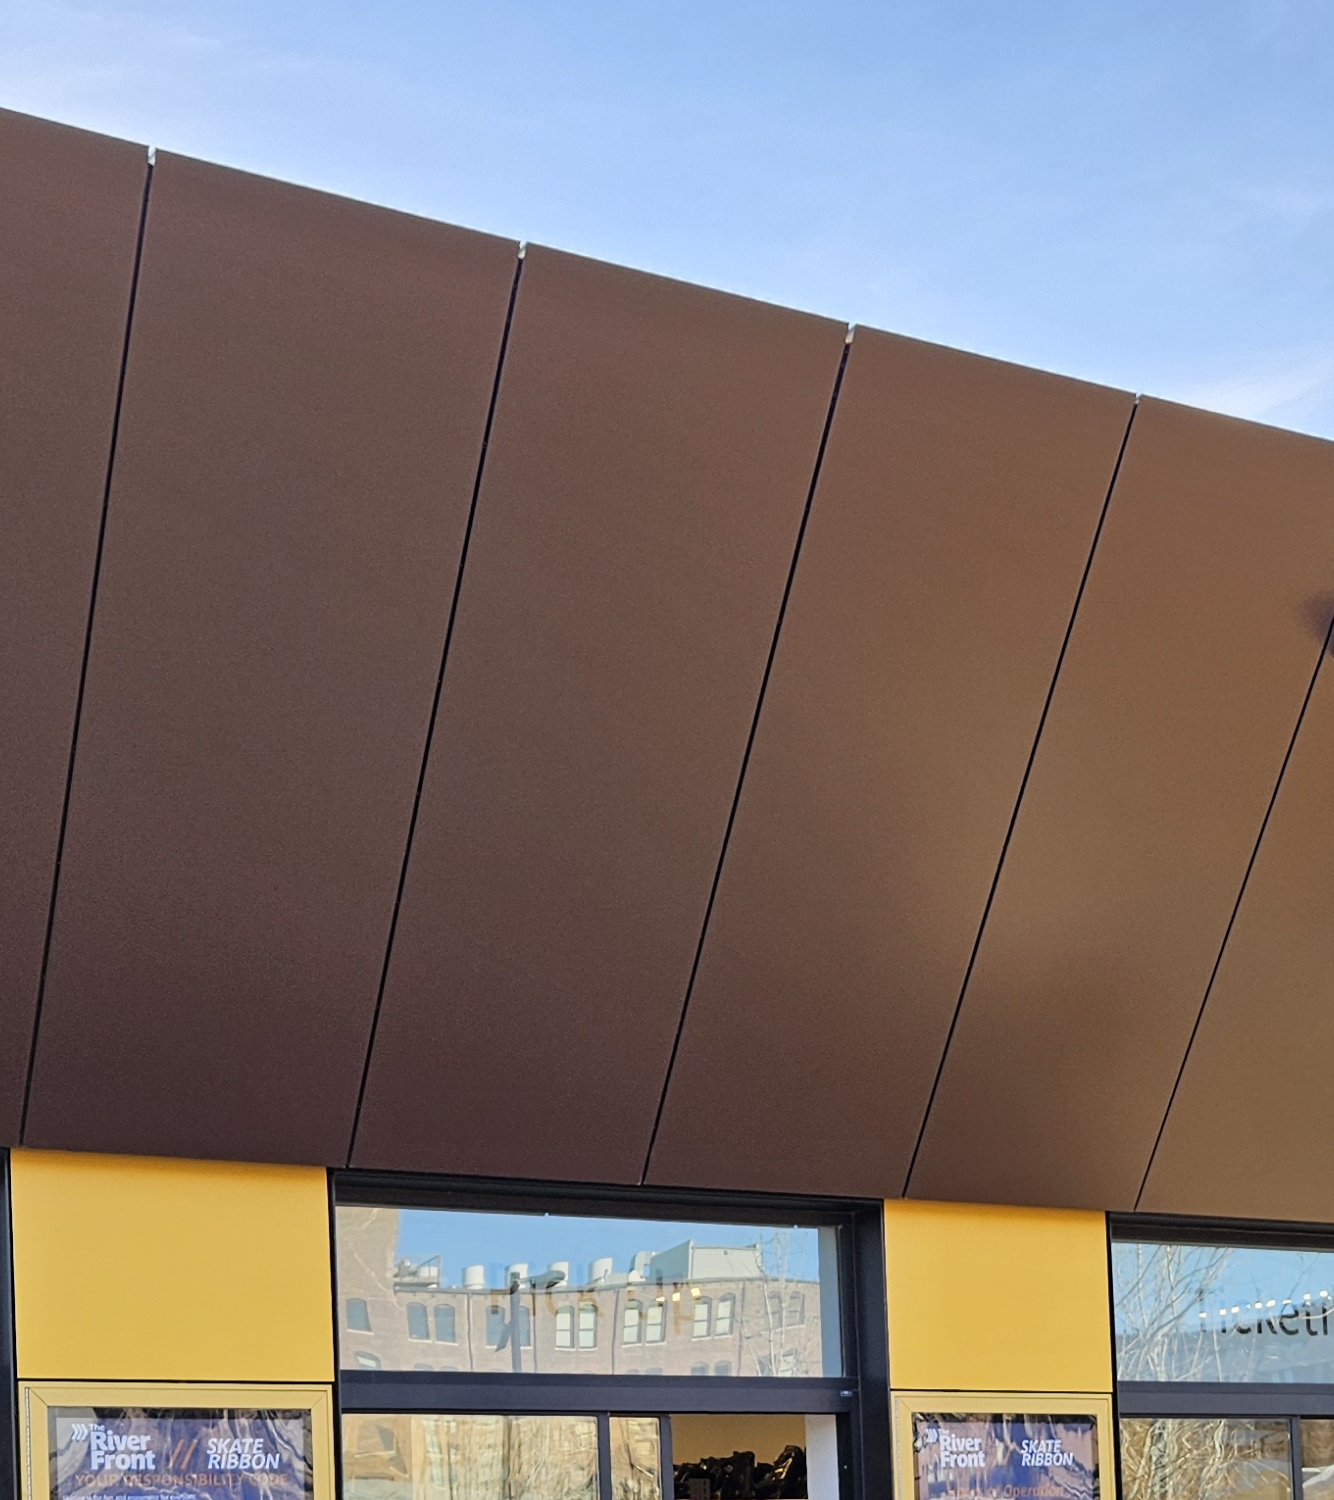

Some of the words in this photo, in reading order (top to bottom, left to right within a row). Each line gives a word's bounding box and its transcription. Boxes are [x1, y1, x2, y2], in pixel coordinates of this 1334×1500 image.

[88, 1423, 105, 1431] The
[89, 1430, 151, 1450] River
[206, 1438, 264, 1454] SKATE
[939, 1434, 982, 1450] River
[1020, 1439, 1062, 1453] SKATE
[90, 1451, 155, 1470] Front
[208, 1453, 280, 1470] RIBBON
[940, 1451, 985, 1468] Front
[1021, 1453, 1073, 1467] RIBBON
[74, 1474, 119, 1487] YOUR
[124, 1473, 245, 1487] RESPONSIBILITY
[248, 1473, 288, 1486] CODE
[1003, 1484, 1064, 1498] Operation
